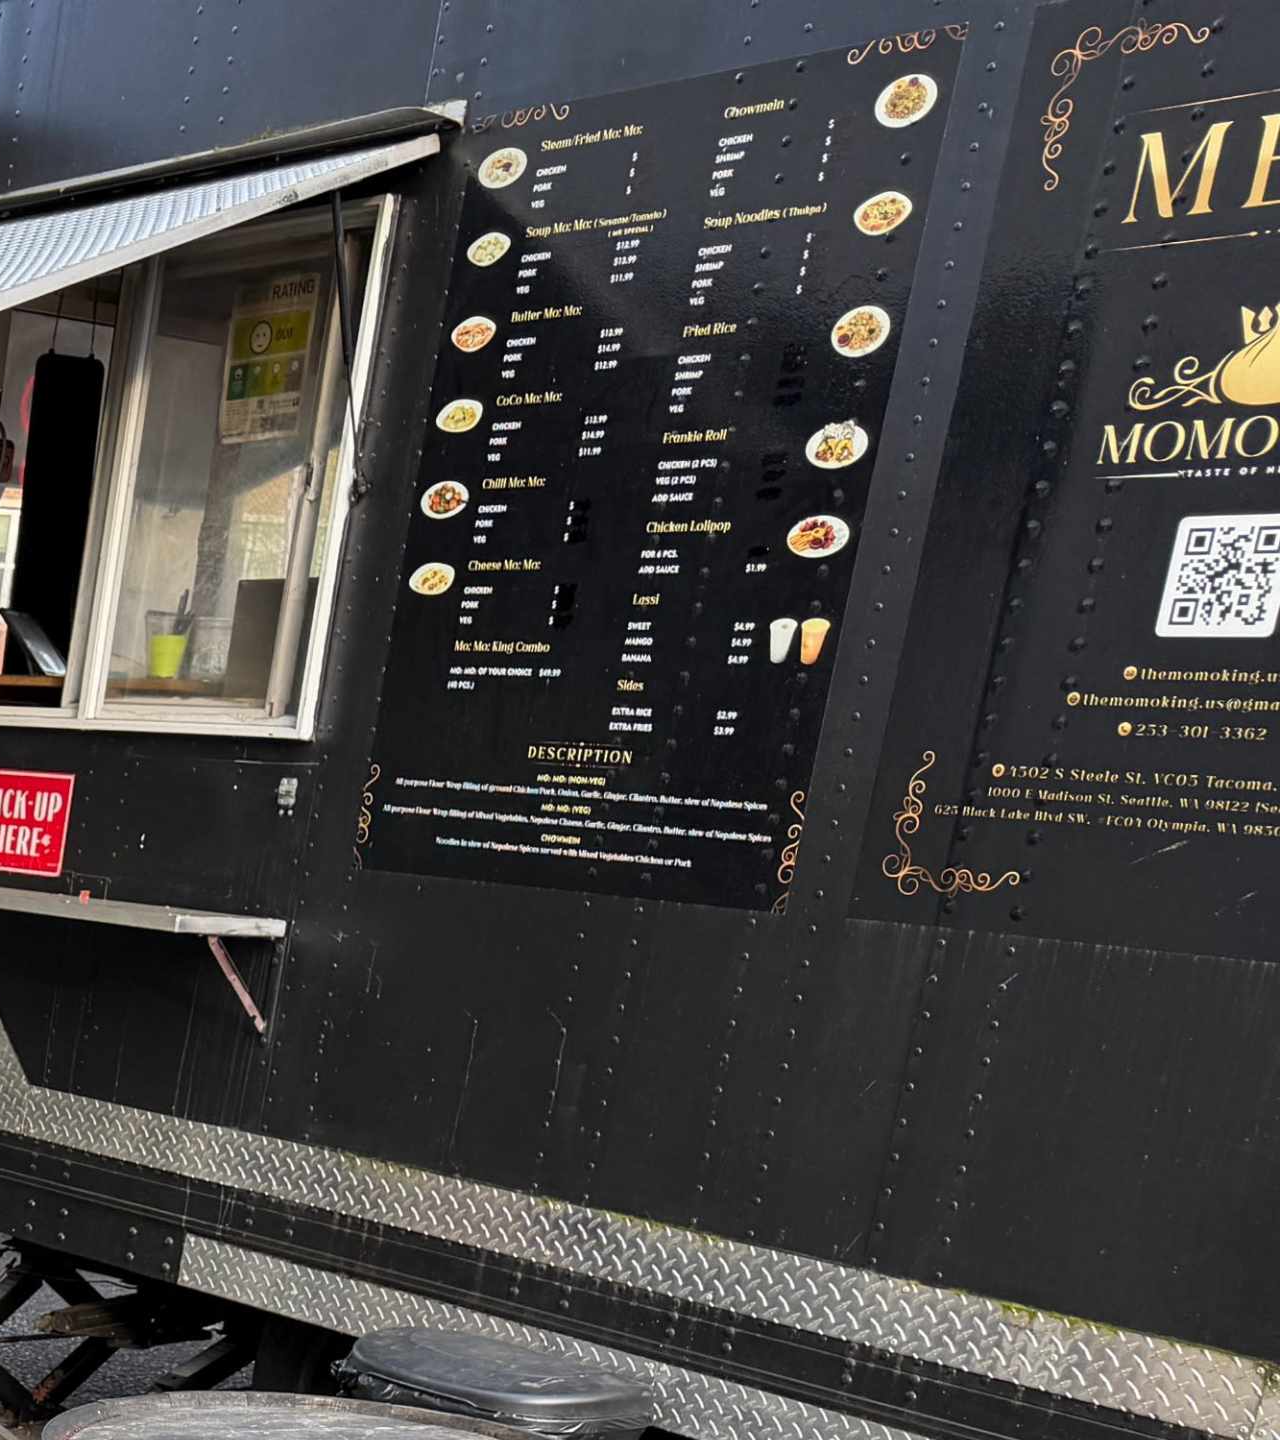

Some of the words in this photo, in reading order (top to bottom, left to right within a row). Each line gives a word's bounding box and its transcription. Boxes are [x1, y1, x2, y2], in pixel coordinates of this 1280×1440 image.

[724, 99, 784, 118] Chowmein
[719, 134, 753, 147] CHICKEN
[716, 151, 745, 163] SHRIMP
[536, 165, 566, 177] CHICKEN
[712, 169, 734, 179] PORK
[533, 182, 552, 192] PORK
[710, 187, 725, 196] VEG
[531, 200, 544, 208] VEG
[704, 217, 732, 228] Soup
[735, 209, 780, 224] Noodles
[526, 227, 551, 237] Soup
[698, 244, 732, 257] CHICKEN
[521, 252, 551, 262] CHICKEN
[695, 261, 724, 272] SHRIMP
[518, 269, 537, 277] PORK
[692, 279, 712, 288] PORK
[272, 279, 316, 299] RATING
[517, 285, 529, 294] VEG
[690, 296, 704, 305] VEG
[511, 311, 542, 322] Butter
[683, 324, 711, 337] Fried
[713, 322, 736, 334] Rice
[507, 337, 536, 347] CHICKEN
[504, 353, 522, 362] PORK
[678, 354, 711, 364] CHICKEN
[502, 370, 515, 378] VEG
[675, 370, 703, 380] SHRIMP
[672, 387, 692, 396] PORK
[497, 395, 522, 406] CoCo
[669, 404, 683, 413] VEG
[492, 422, 521, 430] CHICKEN
[489, 437, 507, 445] PORK
[663, 431, 703, 443] Frankie
[705, 429, 727, 441] Roll
[1096, 415, 1280, 465] MOMO
[488, 453, 500, 461] VEG
[658, 461, 691, 470] CHICKEN
[1187, 468, 1230, 477] TASTE
[1239, 467, 1257, 475] OF
[656, 477, 670, 485] VEG
[652, 494, 668, 502] ADD
[669, 493, 693, 501] SAUCE
[478, 505, 507, 513] CHICKEN
[475, 520, 493, 528] PORK
[647, 521, 688, 532] Chicken
[474, 535, 486, 543] VEG
[641, 550, 656, 558] FOR
[468, 560, 501, 570] Cheese
[639, 566, 654, 574] ADD
[656, 565, 679, 573] SAUCE
[746, 564, 766, 572] $1.99
[633, 594, 660, 605] Lassi
[460, 616, 472, 624] VEG
[628, 622, 651, 630] SWEET
[734, 622, 755, 631] $4.99
[625, 637, 653, 645] MANGO
[732, 638, 752, 647] $4.99
[492, 641, 514, 654] King
[516, 642, 550, 652] Combo
[622, 654, 651, 662] BANANA
[728, 655, 748, 664] $4.99
[478, 667, 487, 675] OF
[489, 667, 506, 675] YOUR
[507, 668, 532, 676] CHOICE
[618, 680, 643, 690] Sides
[612, 707, 634, 715] EXTRA
[636, 708, 652, 716] RICE
[717, 711, 737, 720] $2.99
[609, 722, 631, 730] EXTRA
[633, 723, 652, 732] FRIES
[714, 726, 734, 735] $3.99
[526, 744, 634, 765] DESCRIPTION
[1056, 768, 1064, 778] S
[989, 787, 1020, 797] 1000
[1025, 788, 1035, 799] E
[963, 806, 995, 817] Black
[1001, 809, 1030, 819] Lake
[541, 834, 580, 844] CHOWMEIN
